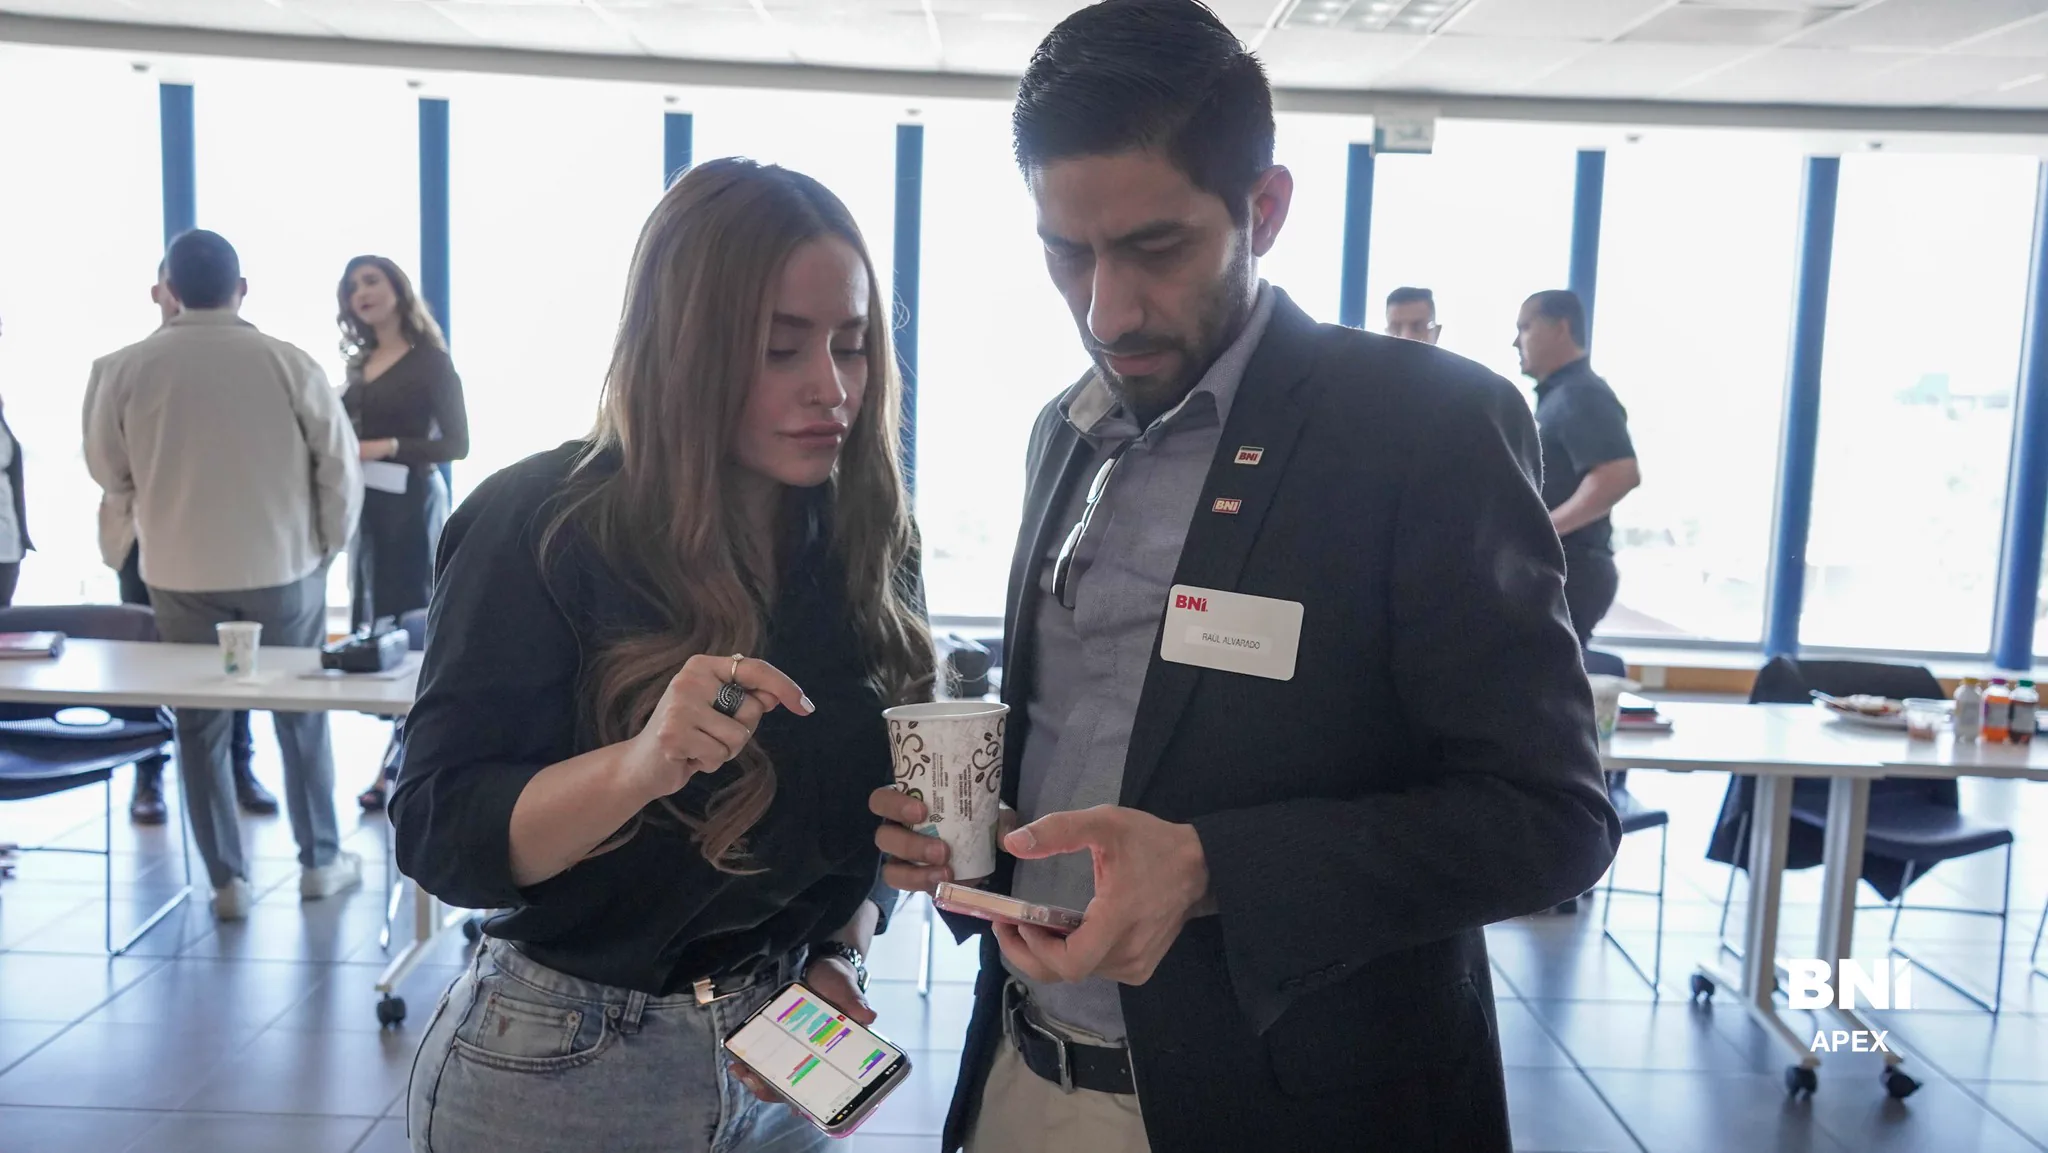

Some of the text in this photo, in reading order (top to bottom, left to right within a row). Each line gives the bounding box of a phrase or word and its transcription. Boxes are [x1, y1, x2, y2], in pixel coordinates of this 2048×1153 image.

[1238, 451, 1258, 462] BNI
[1215, 500, 1239, 511] BNI
[1222, 636, 1261, 650] ALVARADO
